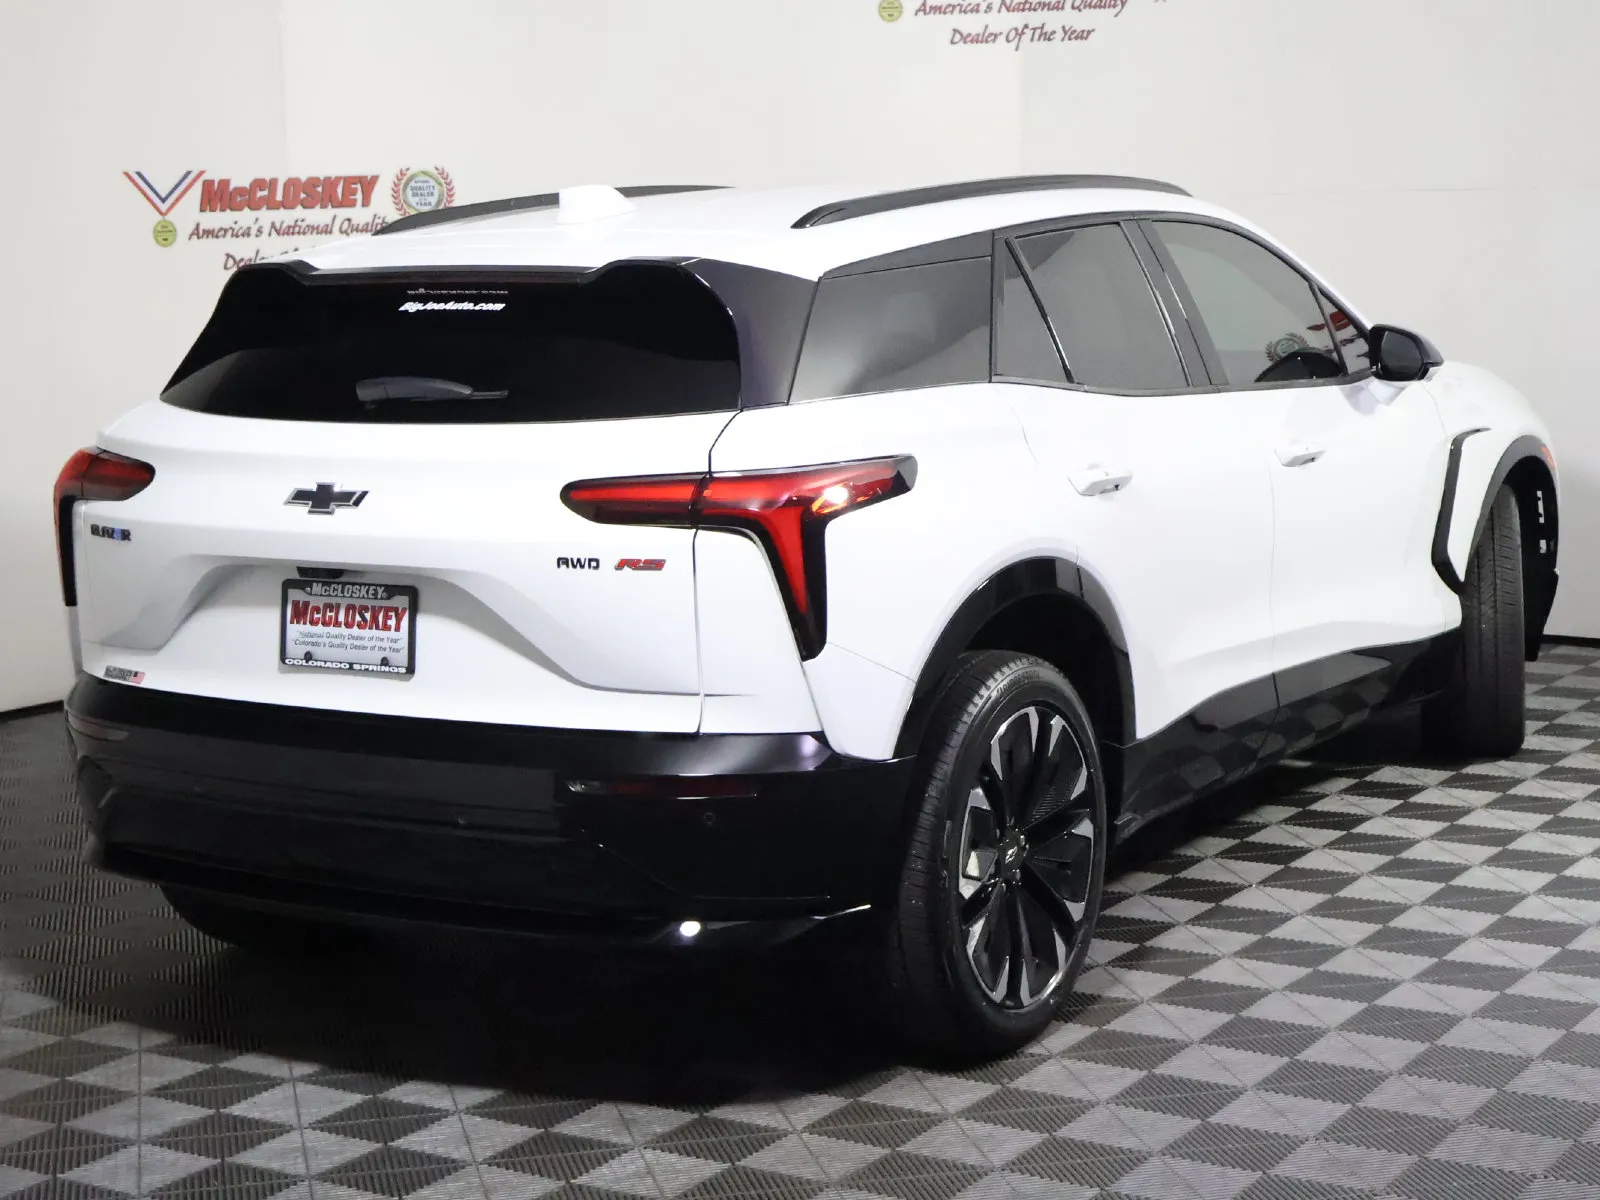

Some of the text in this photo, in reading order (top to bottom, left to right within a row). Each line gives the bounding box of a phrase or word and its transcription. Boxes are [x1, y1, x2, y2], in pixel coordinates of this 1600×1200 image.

[914, 0, 1128, 18] America's National Quality
[949, 23, 1096, 51] Dealer Of The Year
[200, 175, 380, 213] McCLOSKEY
[188, 213, 391, 240] America's National Qualit
[556, 556, 600, 571] AWD
[613, 558, 667, 571] RS
[311, 582, 385, 599] McCLOSKEY
[289, 599, 408, 633] McCLOSKEY
[284, 658, 407, 674] COLORADO SPRINGS
